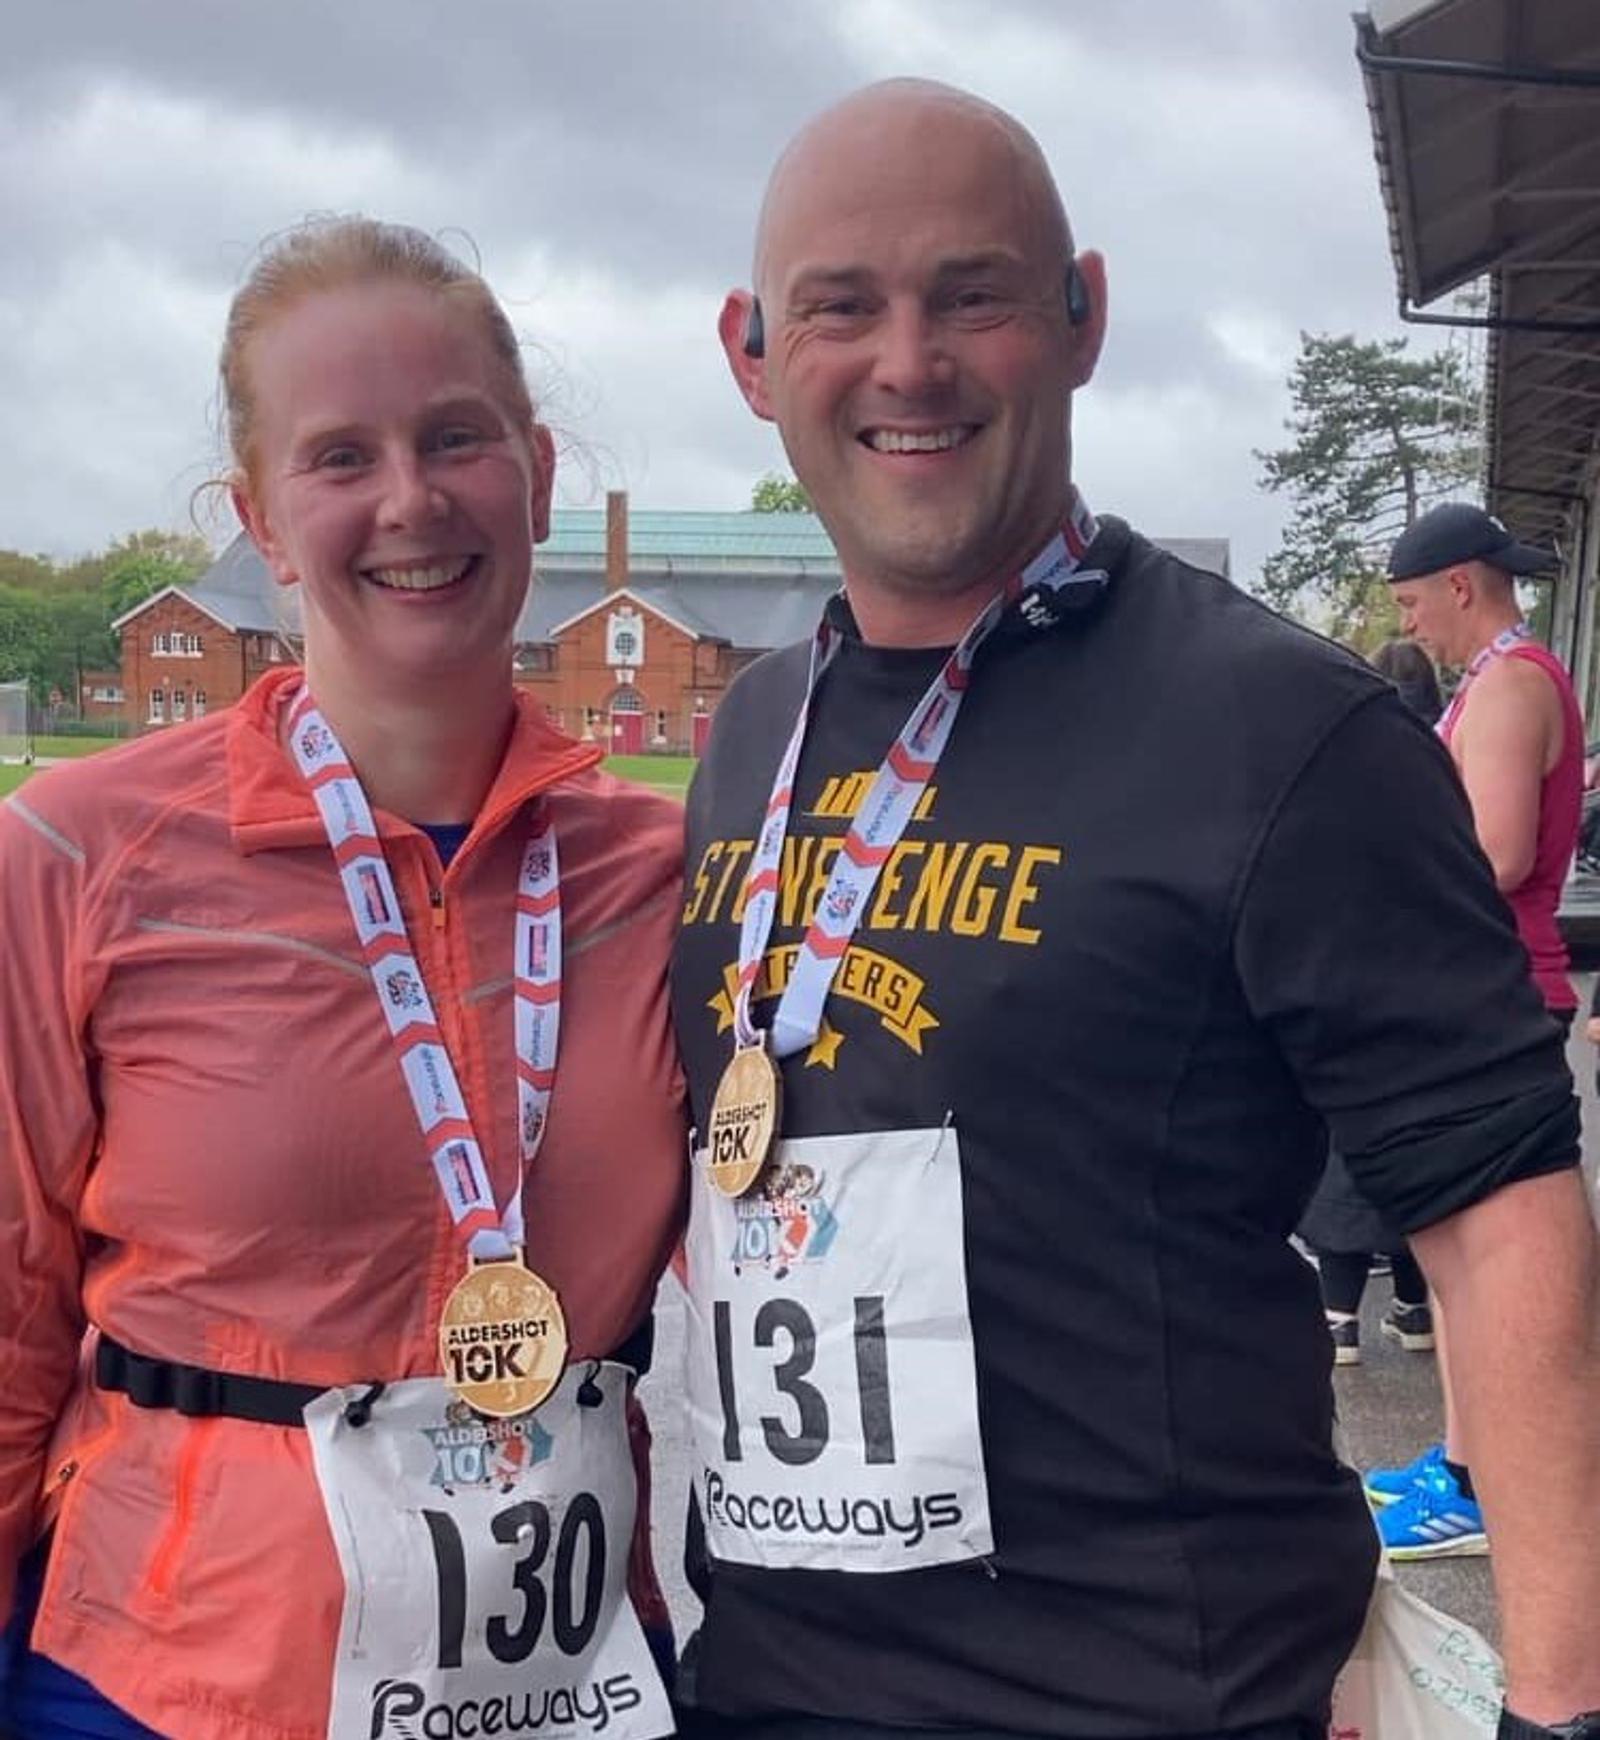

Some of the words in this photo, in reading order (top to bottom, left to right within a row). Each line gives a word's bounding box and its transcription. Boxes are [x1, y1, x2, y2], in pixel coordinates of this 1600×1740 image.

[682, 835, 1061, 945] STNEENGE
[744, 948, 909, 1012] TERS
[712, 1125, 750, 1165] 10K
[448, 1319, 548, 1345] ALDERSHOT
[449, 1342, 527, 1385] 10K
[713, 1296, 896, 1466] 131
[705, 1468, 963, 1548] Raceways
[423, 1492, 606, 1669] 130
[370, 1673, 642, 1740] Raceways
